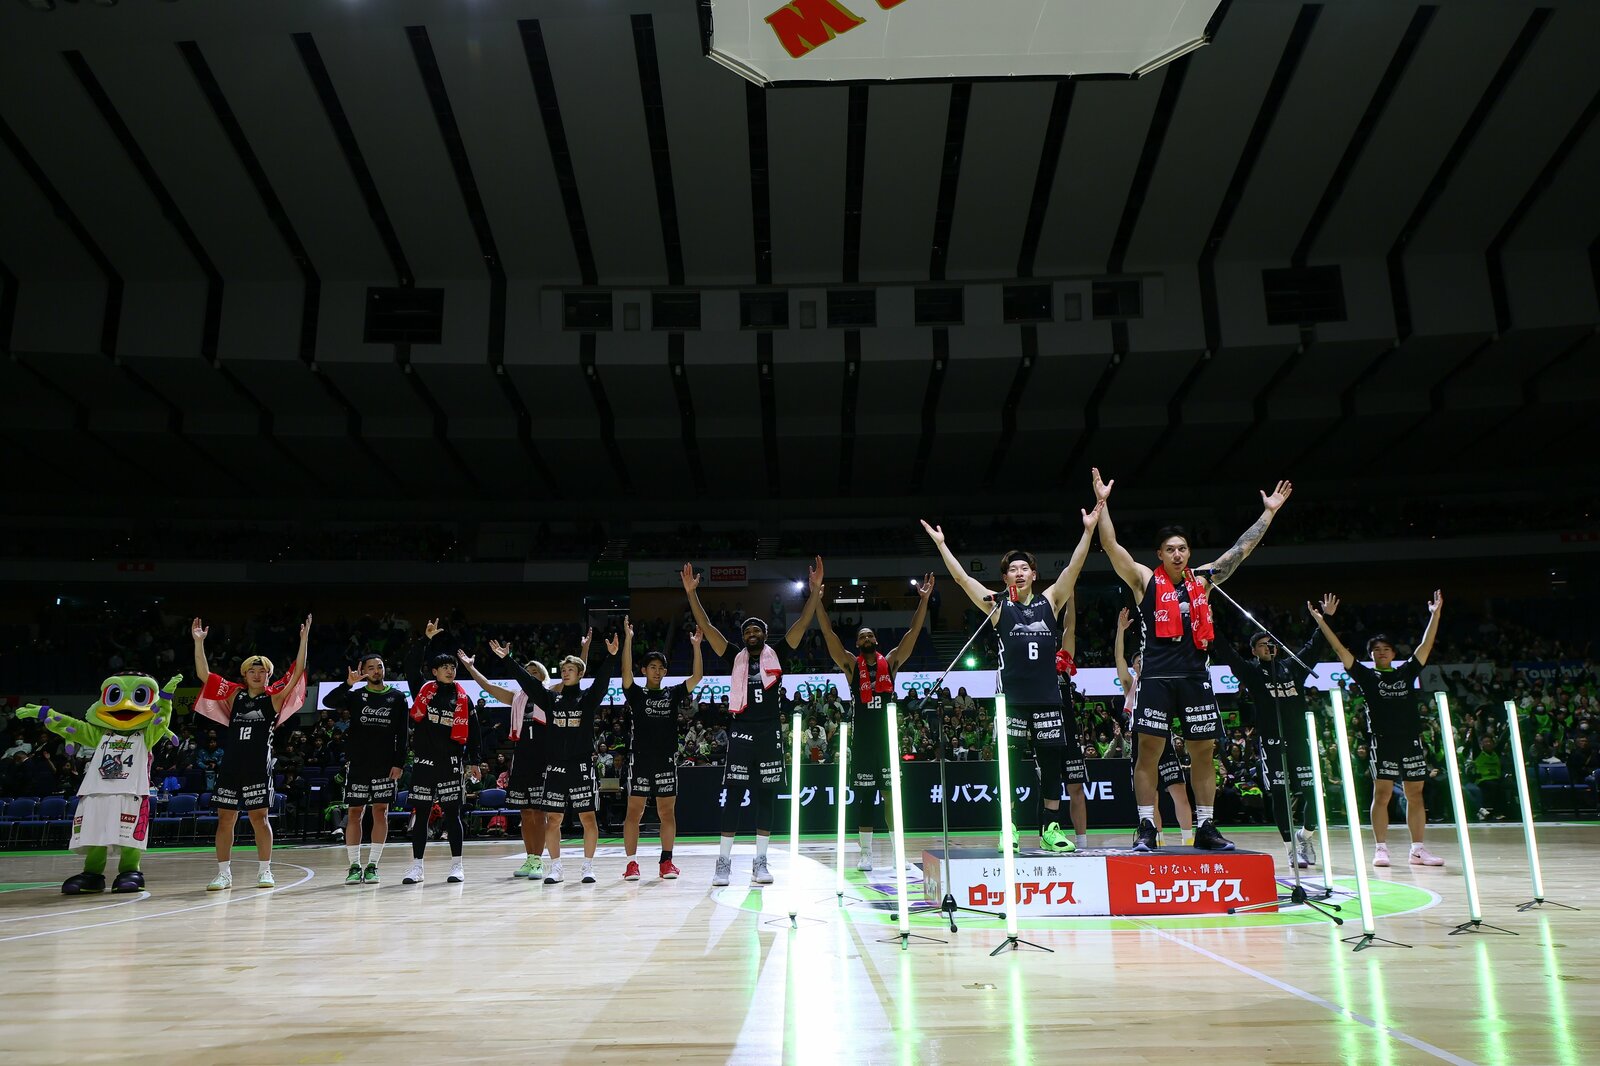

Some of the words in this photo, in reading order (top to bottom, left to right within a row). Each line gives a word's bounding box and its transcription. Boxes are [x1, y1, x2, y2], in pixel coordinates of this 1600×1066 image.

[1028, 641, 1039, 660] 6
[692, 685, 731, 695] COOP
[754, 688, 763, 703] 5
[645, 698, 672, 709] Coca-Cola
[868, 696, 882, 709] 22
[361, 705, 393, 717] Coca-Cola
[239, 726, 252, 741] 12
[1190, 722, 1216, 734] Coca-Cola
[1036, 729, 1061, 740] Coca-Cola
[419, 759, 435, 767] JAL
[552, 766, 567, 774] JAL
[983, 866, 1062, 877] とけい、情熱。
[1149, 863, 1229, 875] とけない、情熱。
[1135, 879, 1245, 904] ロックアイス
